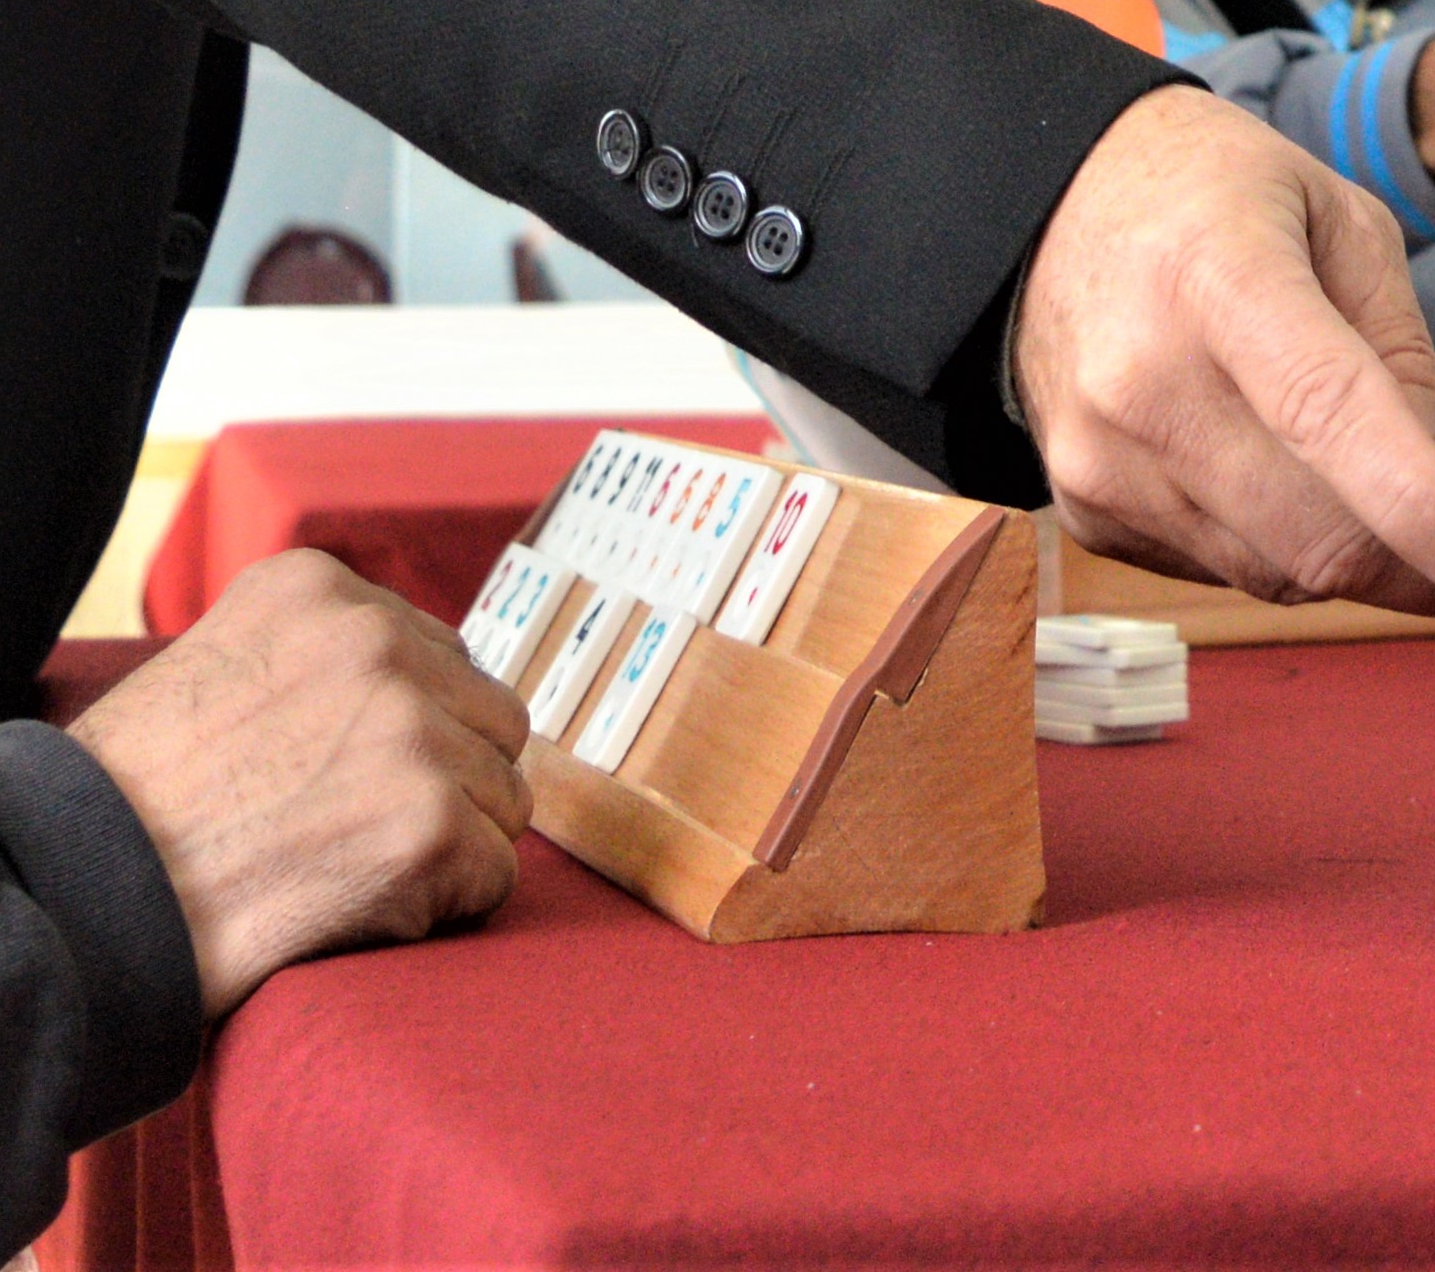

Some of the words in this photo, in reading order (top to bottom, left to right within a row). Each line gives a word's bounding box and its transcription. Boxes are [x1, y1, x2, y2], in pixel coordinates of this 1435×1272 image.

[648, 462, 681, 517] 6
[714, 478, 752, 538] 5
[764, 490, 808, 555] 10
[573, 598, 606, 655] 4
[623, 618, 666, 683] 13
